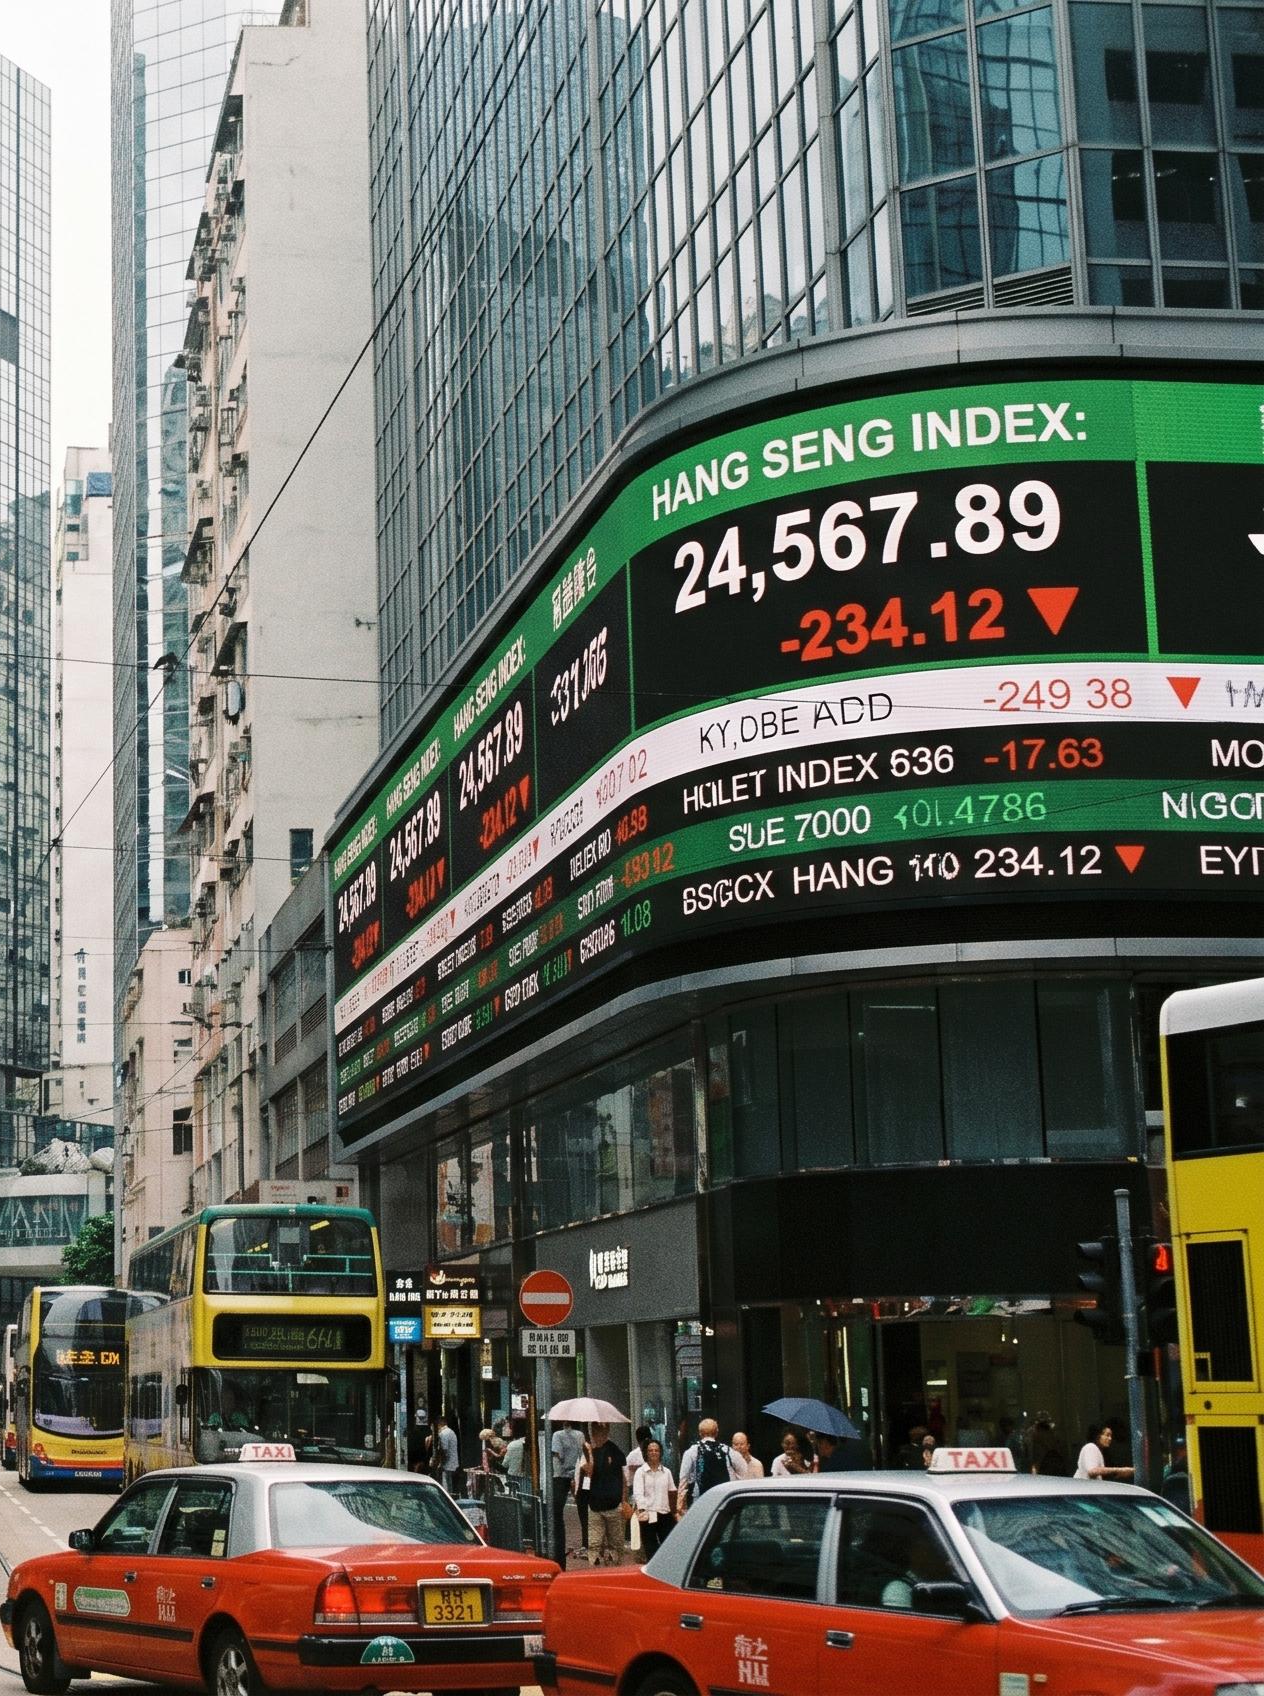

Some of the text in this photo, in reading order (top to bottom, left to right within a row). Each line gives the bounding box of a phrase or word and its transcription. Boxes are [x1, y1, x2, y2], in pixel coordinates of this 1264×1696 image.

[652, 402, 1088, 520] HANG SENG INDEX:
[674, 480, 1061, 614] 24,567.89
[781, 588, 1005, 661] -234.12
[454, 695, 474, 741] HANG
[476, 668, 496, 716] SENG
[459, 701, 523, 811] 24,567.89
[778, 752, 879, 793] INDEX
[890, 745, 953, 777] 636
[984, 738, 1104, 770] -17.63
[390, 791, 440, 881] 24,567.89
[794, 806, 871, 841] 7000
[793, 856, 894, 894] HANG
[974, 845, 1102, 878] 234.12
[252, 1446, 292, 1458] TAXI
[948, 1451, 1007, 1468] TAXI
[434, 1604, 474, 1620] 3321
